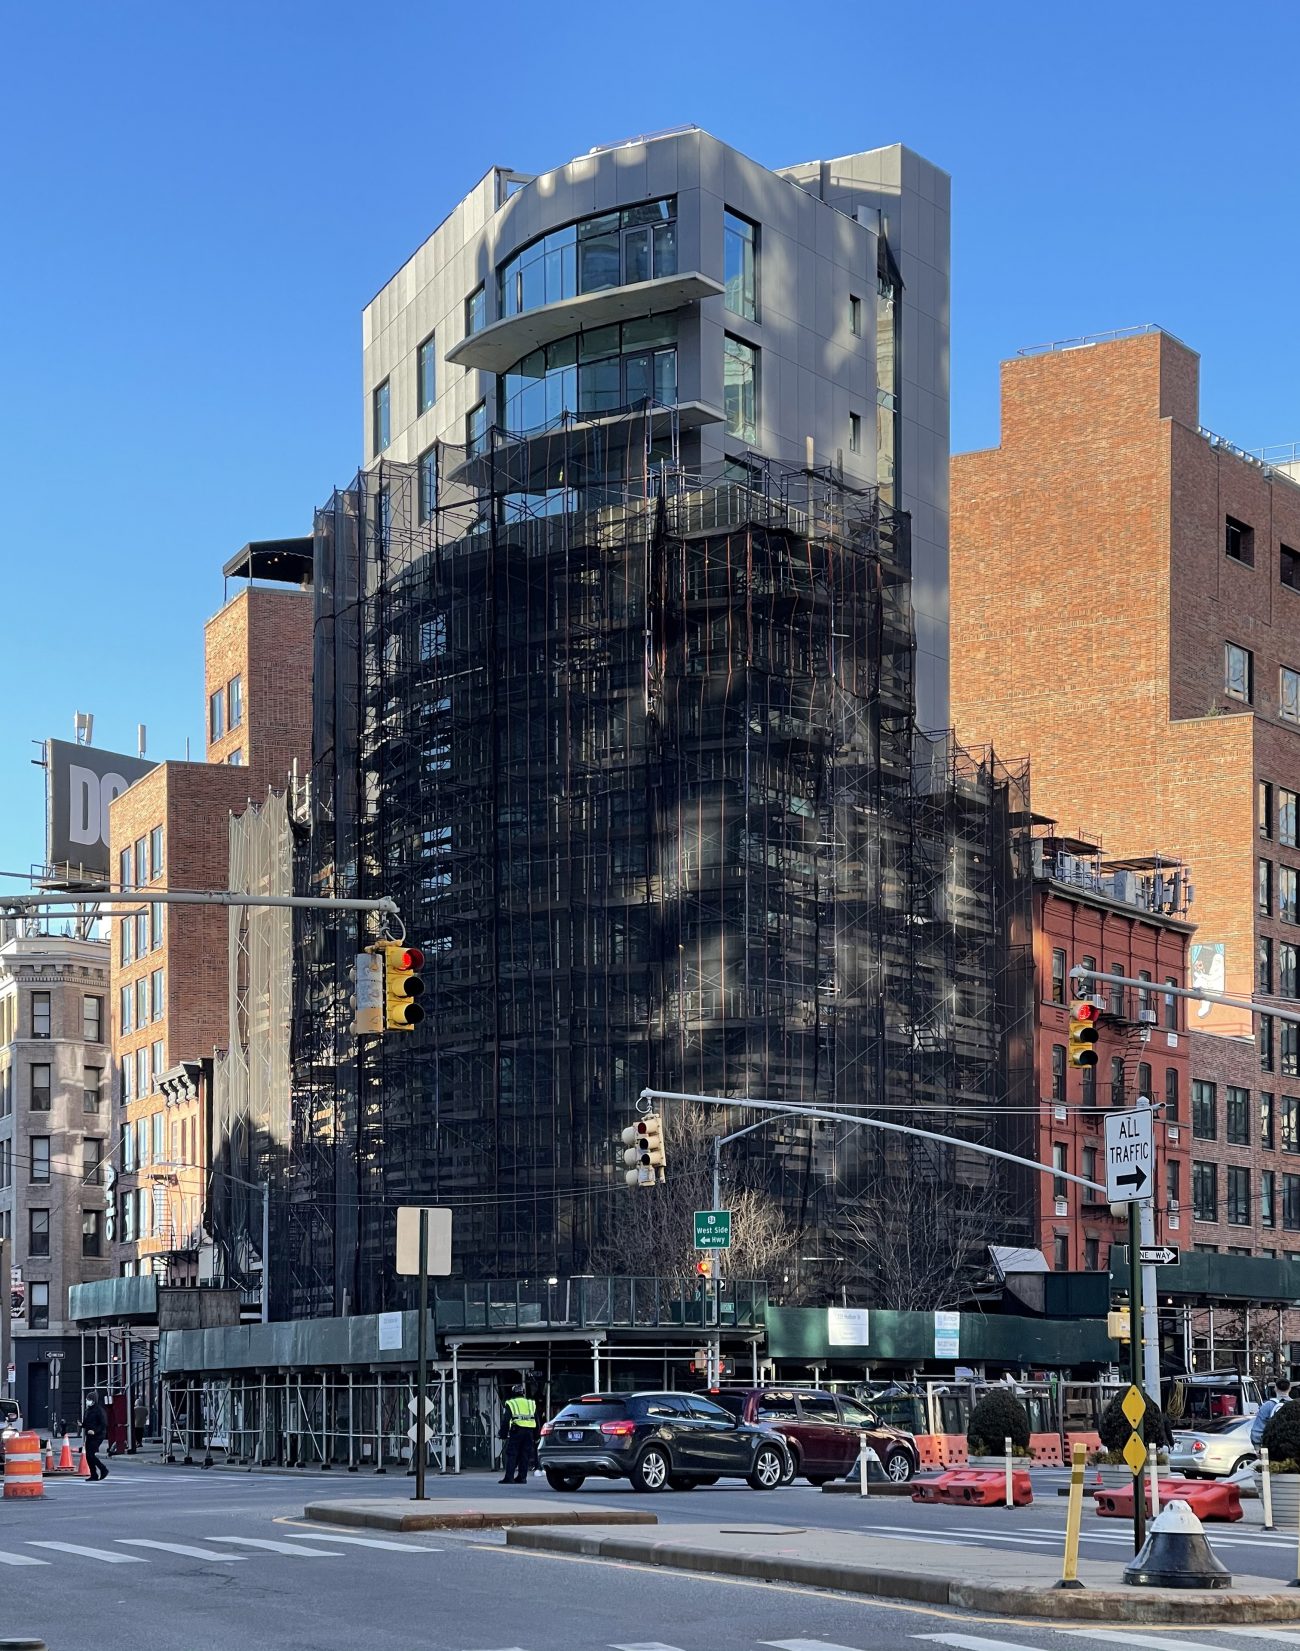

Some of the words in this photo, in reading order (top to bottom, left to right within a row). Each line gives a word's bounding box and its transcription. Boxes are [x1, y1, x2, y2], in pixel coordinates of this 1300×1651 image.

[1119, 1119, 1140, 1139] ALL
[1110, 1142, 1149, 1164] TRAFFIC
[714, 1226, 728, 1234] Side
[711, 1236, 725, 1245] Hwy
[1140, 1251, 1149, 1259] NE
[1155, 1252, 1171, 1260] WAY
